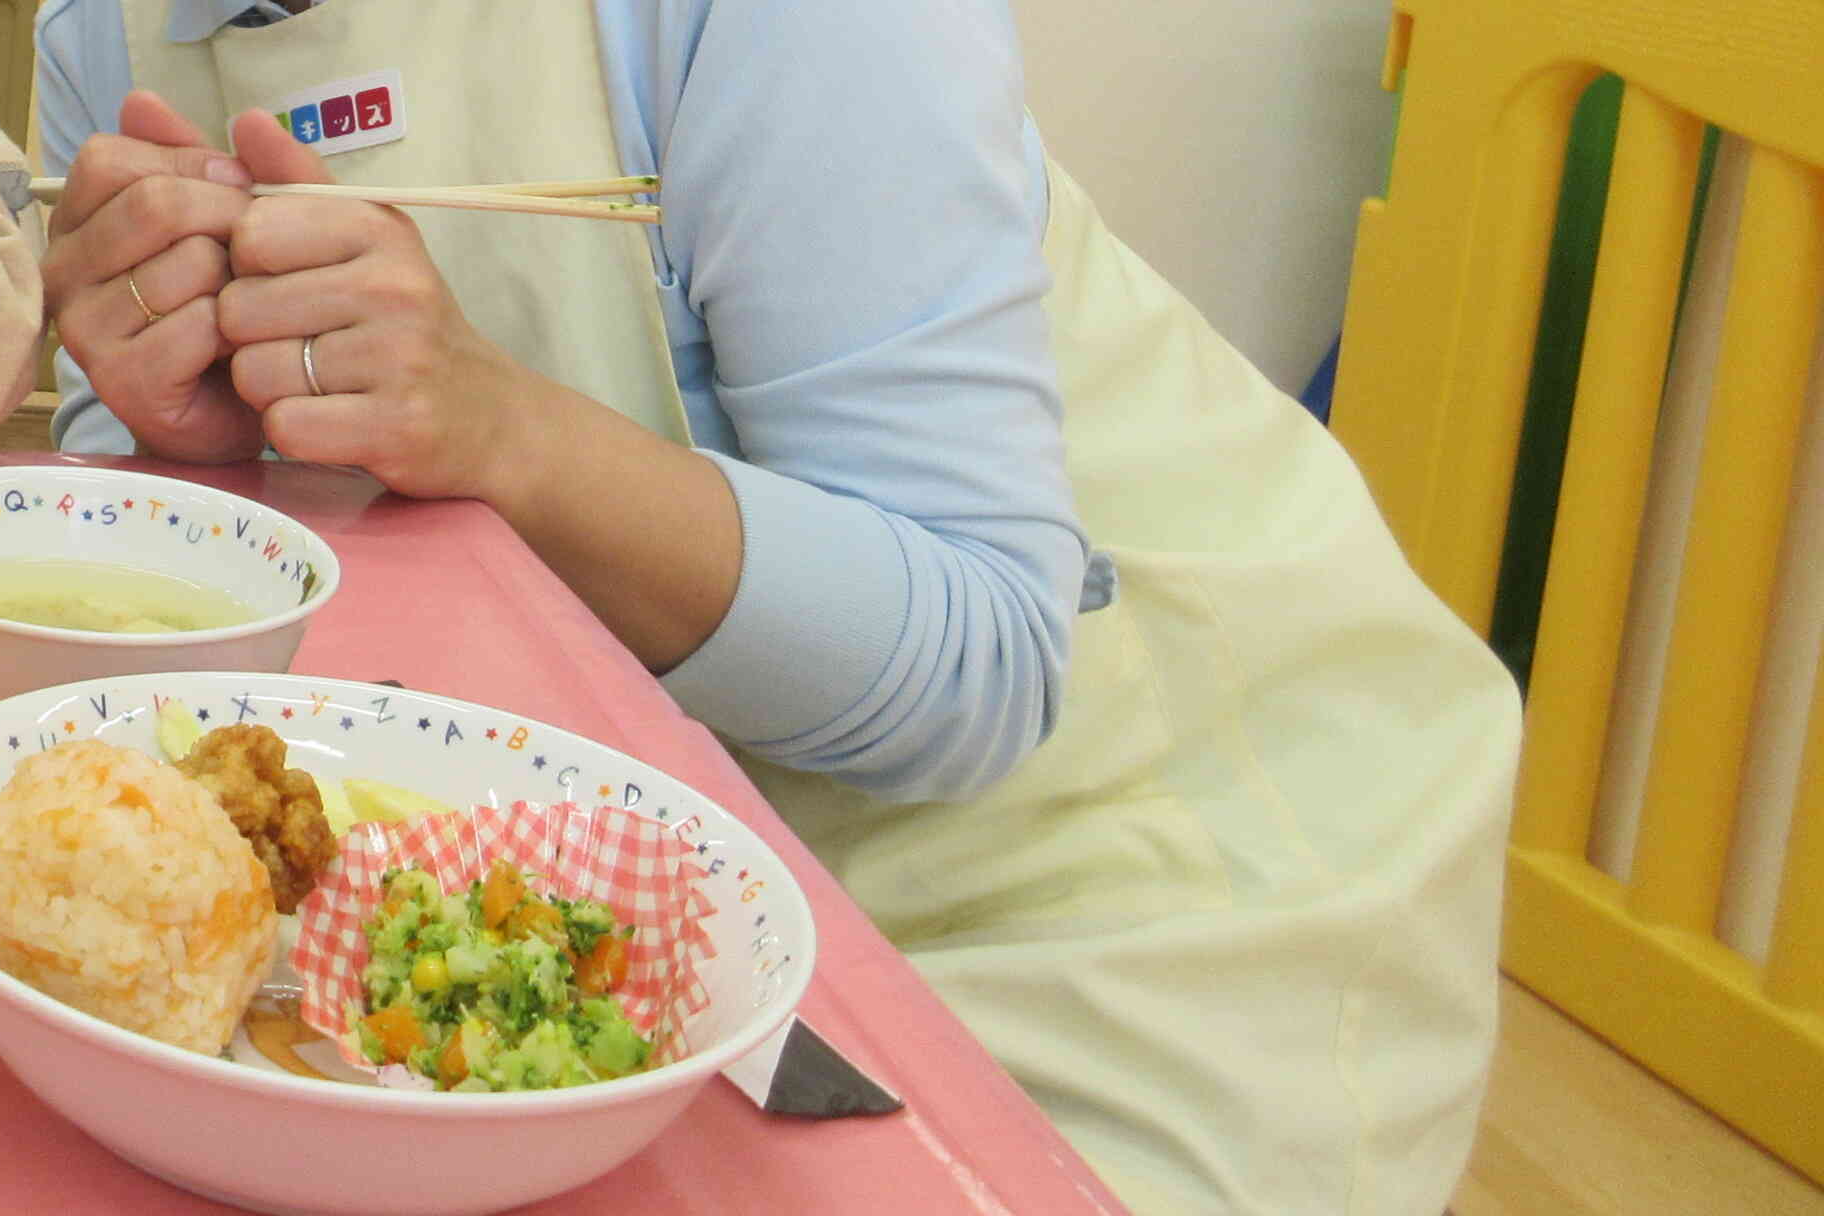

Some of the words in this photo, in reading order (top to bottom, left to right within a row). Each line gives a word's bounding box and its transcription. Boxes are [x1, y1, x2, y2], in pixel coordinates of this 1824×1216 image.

[4, 490, 28, 512] Q
[57, 494, 74, 516] R
[101, 504, 118, 525] S
[148, 499, 166, 521] T
[185, 522, 204, 544] U
[236, 517, 250, 539] V
[262, 535, 282, 561] W
[291, 559, 305, 582] X
[90, 693, 107, 720] V
[231, 693, 257, 724] X
[311, 692, 332, 717] Y
[371, 696, 396, 724] Z
[445, 719, 464, 745] A
[506, 727, 529, 750] B
[557, 765, 580, 787] C
[624, 782, 642, 808] D
[675, 815, 702, 841] E
[740, 880, 765, 904] G
